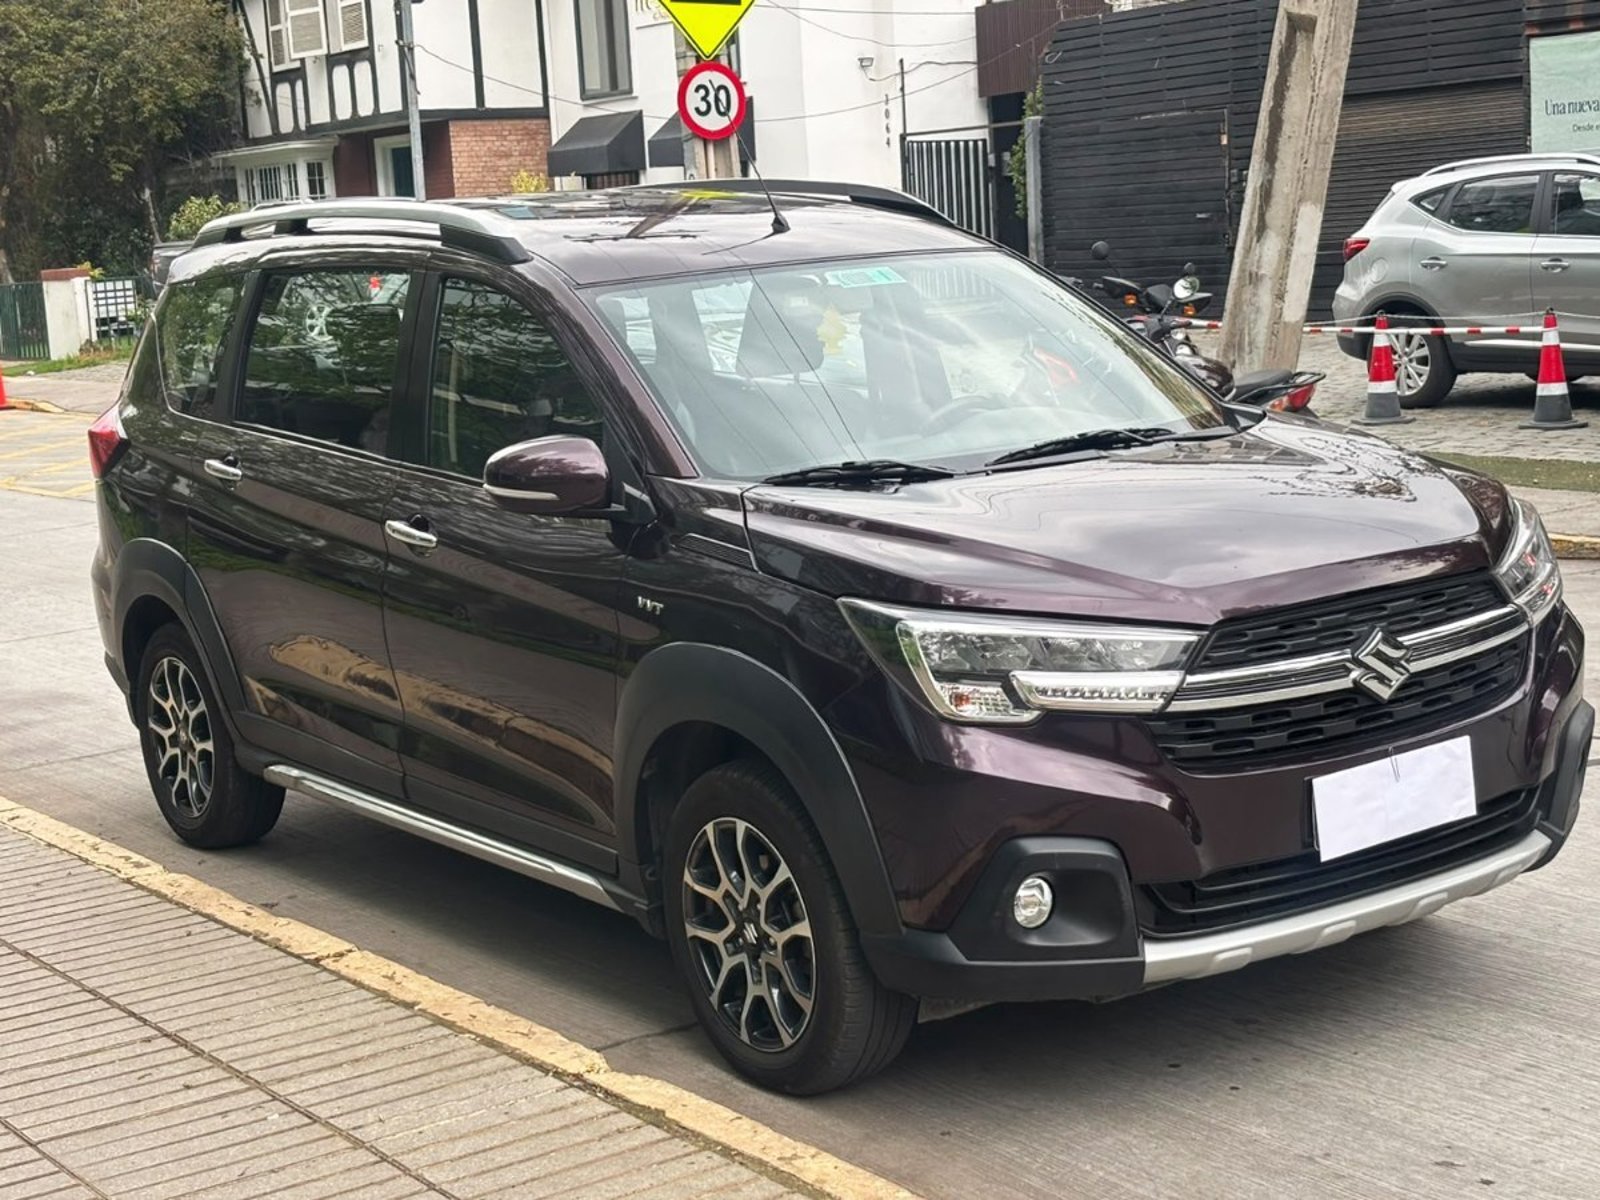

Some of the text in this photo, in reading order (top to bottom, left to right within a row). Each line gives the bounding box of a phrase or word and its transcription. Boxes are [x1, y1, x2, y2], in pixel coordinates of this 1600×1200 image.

[693, 84, 732, 117] 30
[1544, 99, 1600, 116] Una nueva
[1572, 122, 1594, 132] Desde
